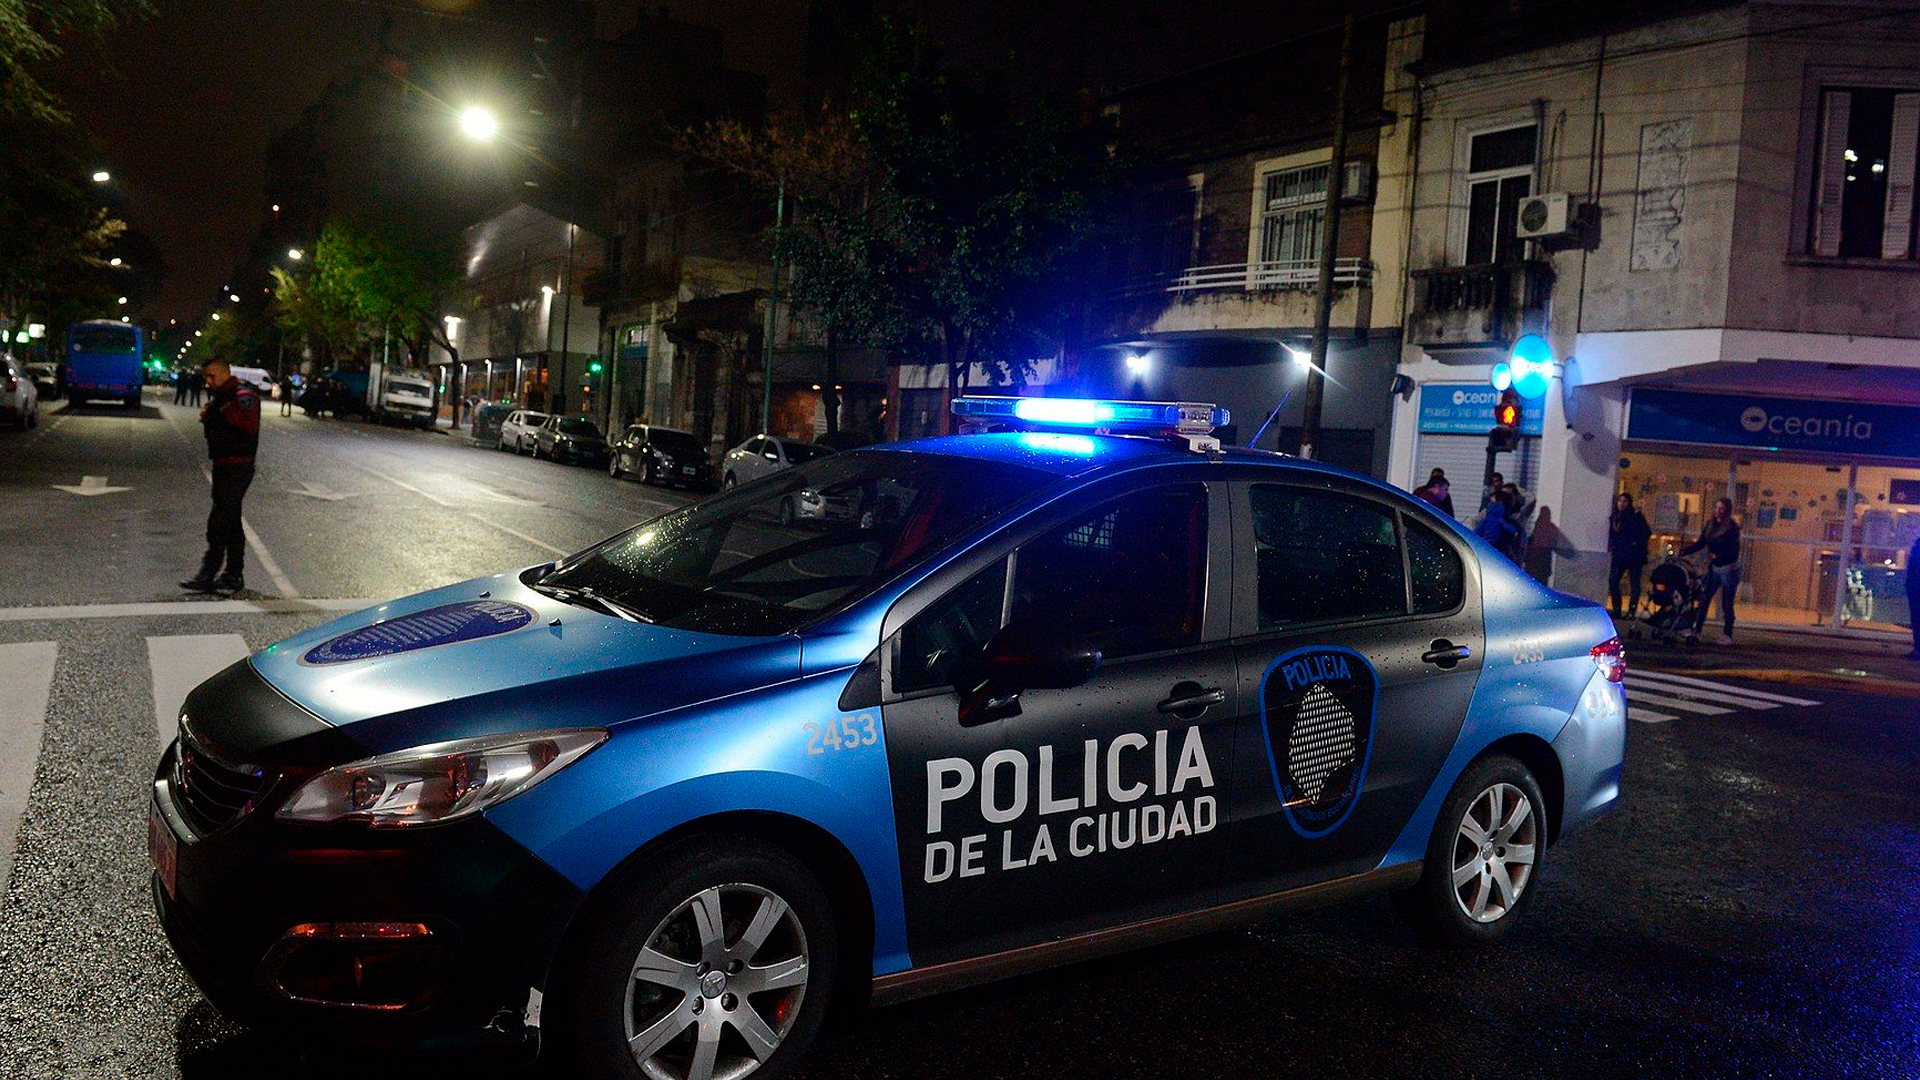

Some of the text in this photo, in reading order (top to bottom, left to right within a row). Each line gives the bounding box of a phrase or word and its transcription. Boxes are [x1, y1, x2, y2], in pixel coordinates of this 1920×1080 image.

[1281, 655, 1352, 691] POLICIA
[802, 713, 879, 756] 2453
[926, 725, 1215, 834] POLICIA
[924, 795, 1217, 884] DE LA CIUDAD
